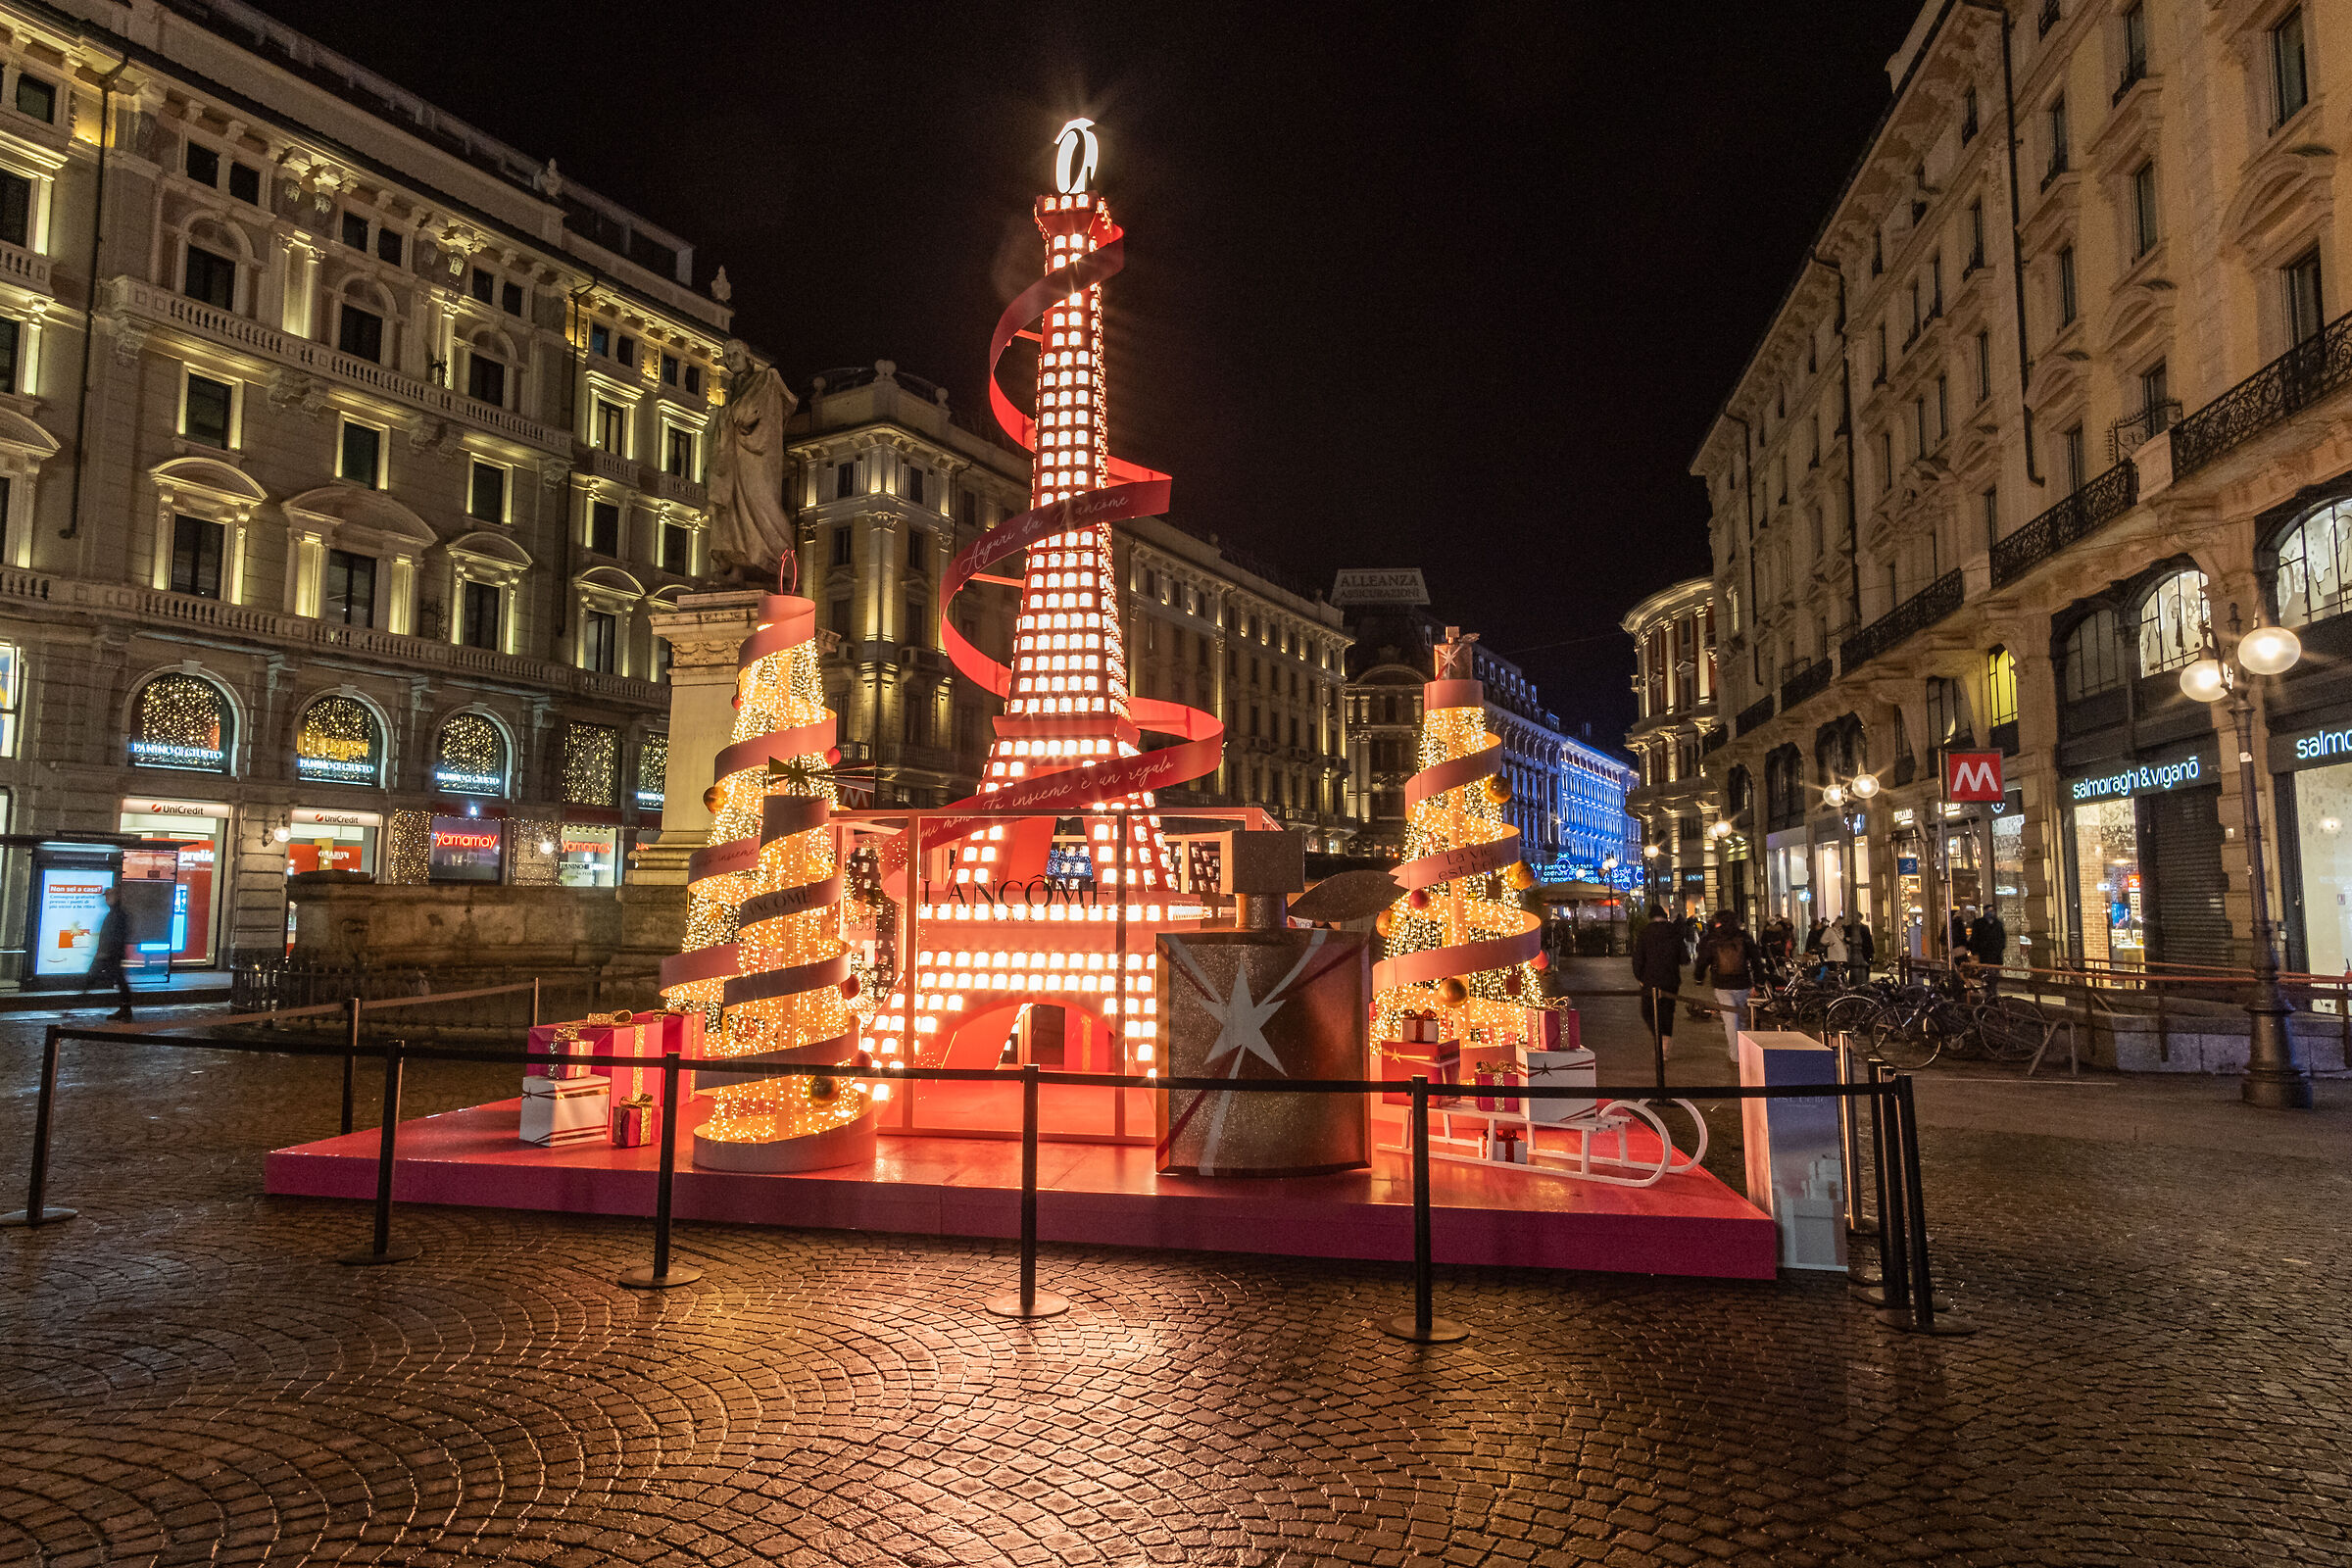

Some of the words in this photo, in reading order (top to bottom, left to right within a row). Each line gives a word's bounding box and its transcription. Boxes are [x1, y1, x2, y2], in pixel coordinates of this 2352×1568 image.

[959, 532, 1014, 575] Auguri
[1340, 574, 1419, 587] ALLEANZA
[133, 743, 173, 756] PANINO
[184, 748, 223, 760] GIUSTO
[1012, 784, 1072, 808] insieme
[1099, 774, 1120, 787] un
[1128, 755, 1174, 788] regalo
[1953, 761, 1999, 792] M
[163, 805, 204, 815] UniCredit
[324, 814, 359, 824] UniCredit
[923, 874, 1110, 909] LANCÔME
